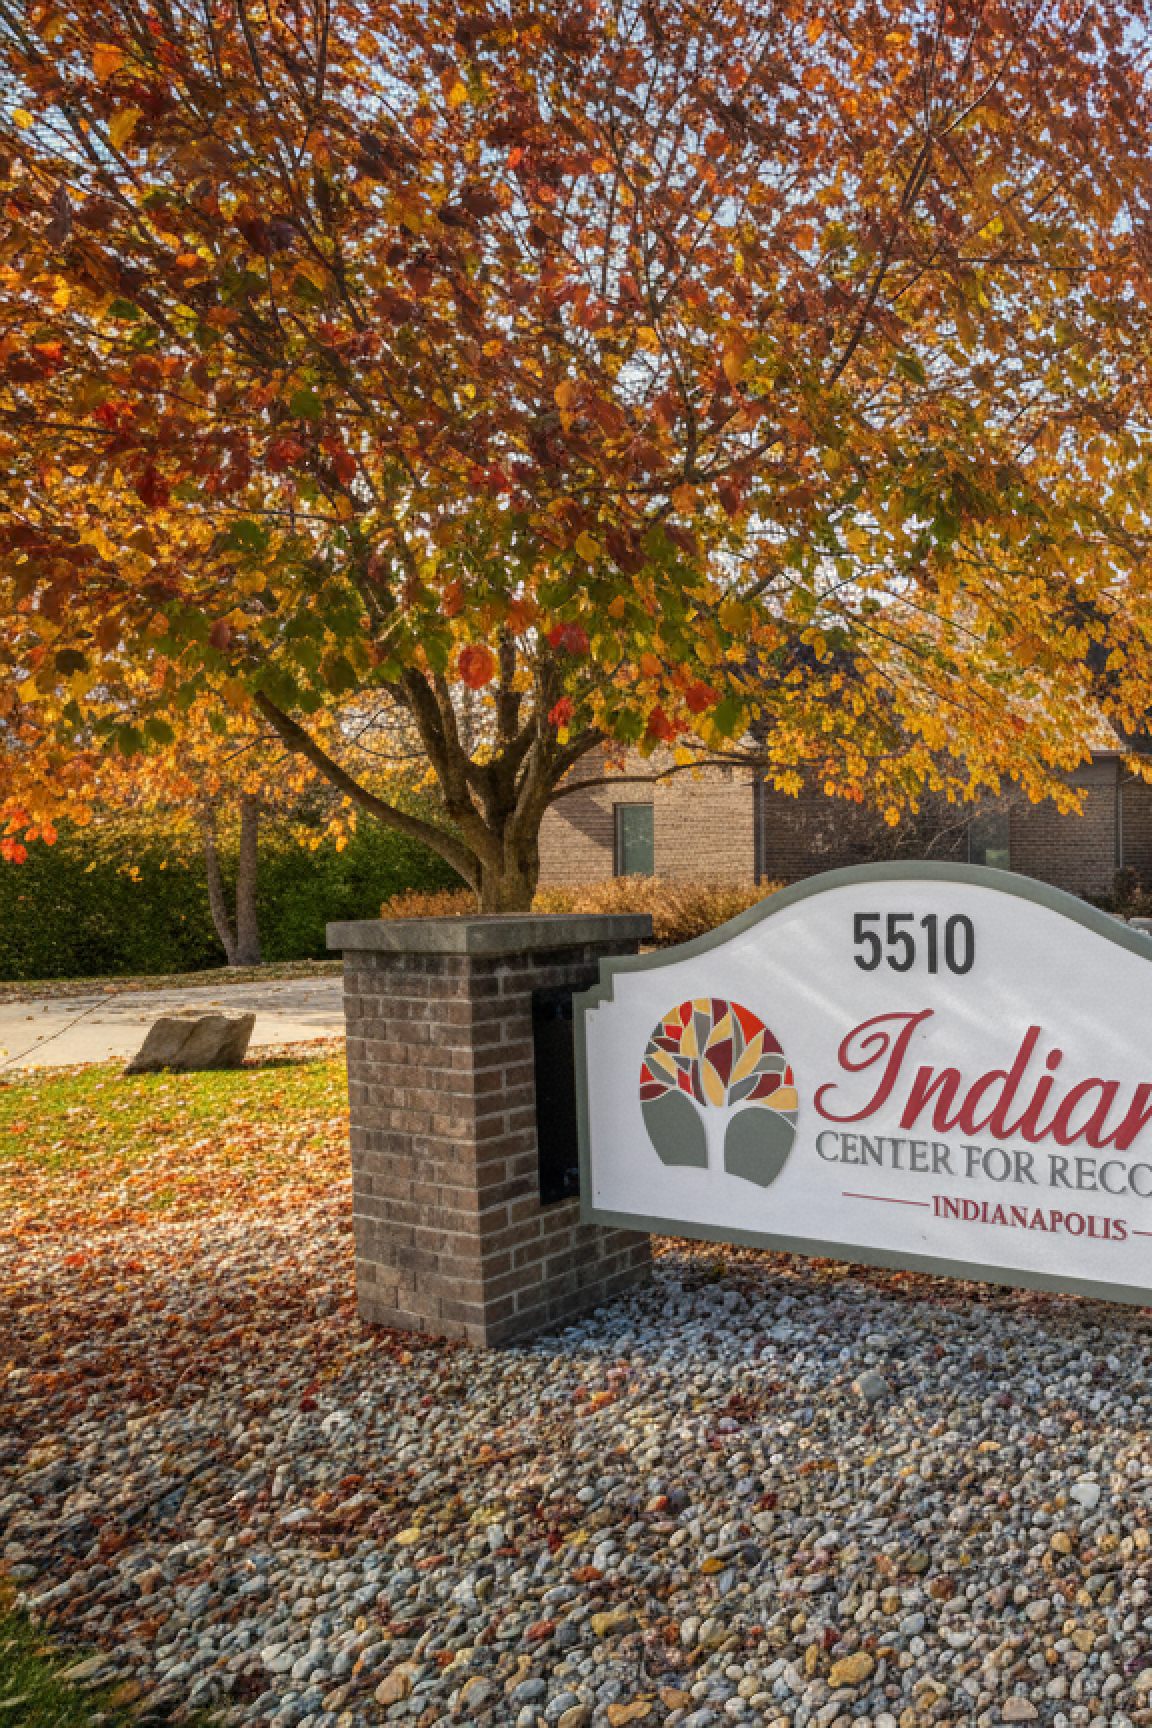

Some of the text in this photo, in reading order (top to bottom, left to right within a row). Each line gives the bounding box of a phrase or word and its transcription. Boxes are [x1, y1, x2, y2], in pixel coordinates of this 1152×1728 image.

[853, 912, 976, 975] 5510
[815, 1130, 957, 1175] CENTER
[964, 1146, 1037, 1187] FOR
[932, 1196, 1128, 1241] INDIANAPOLIS
